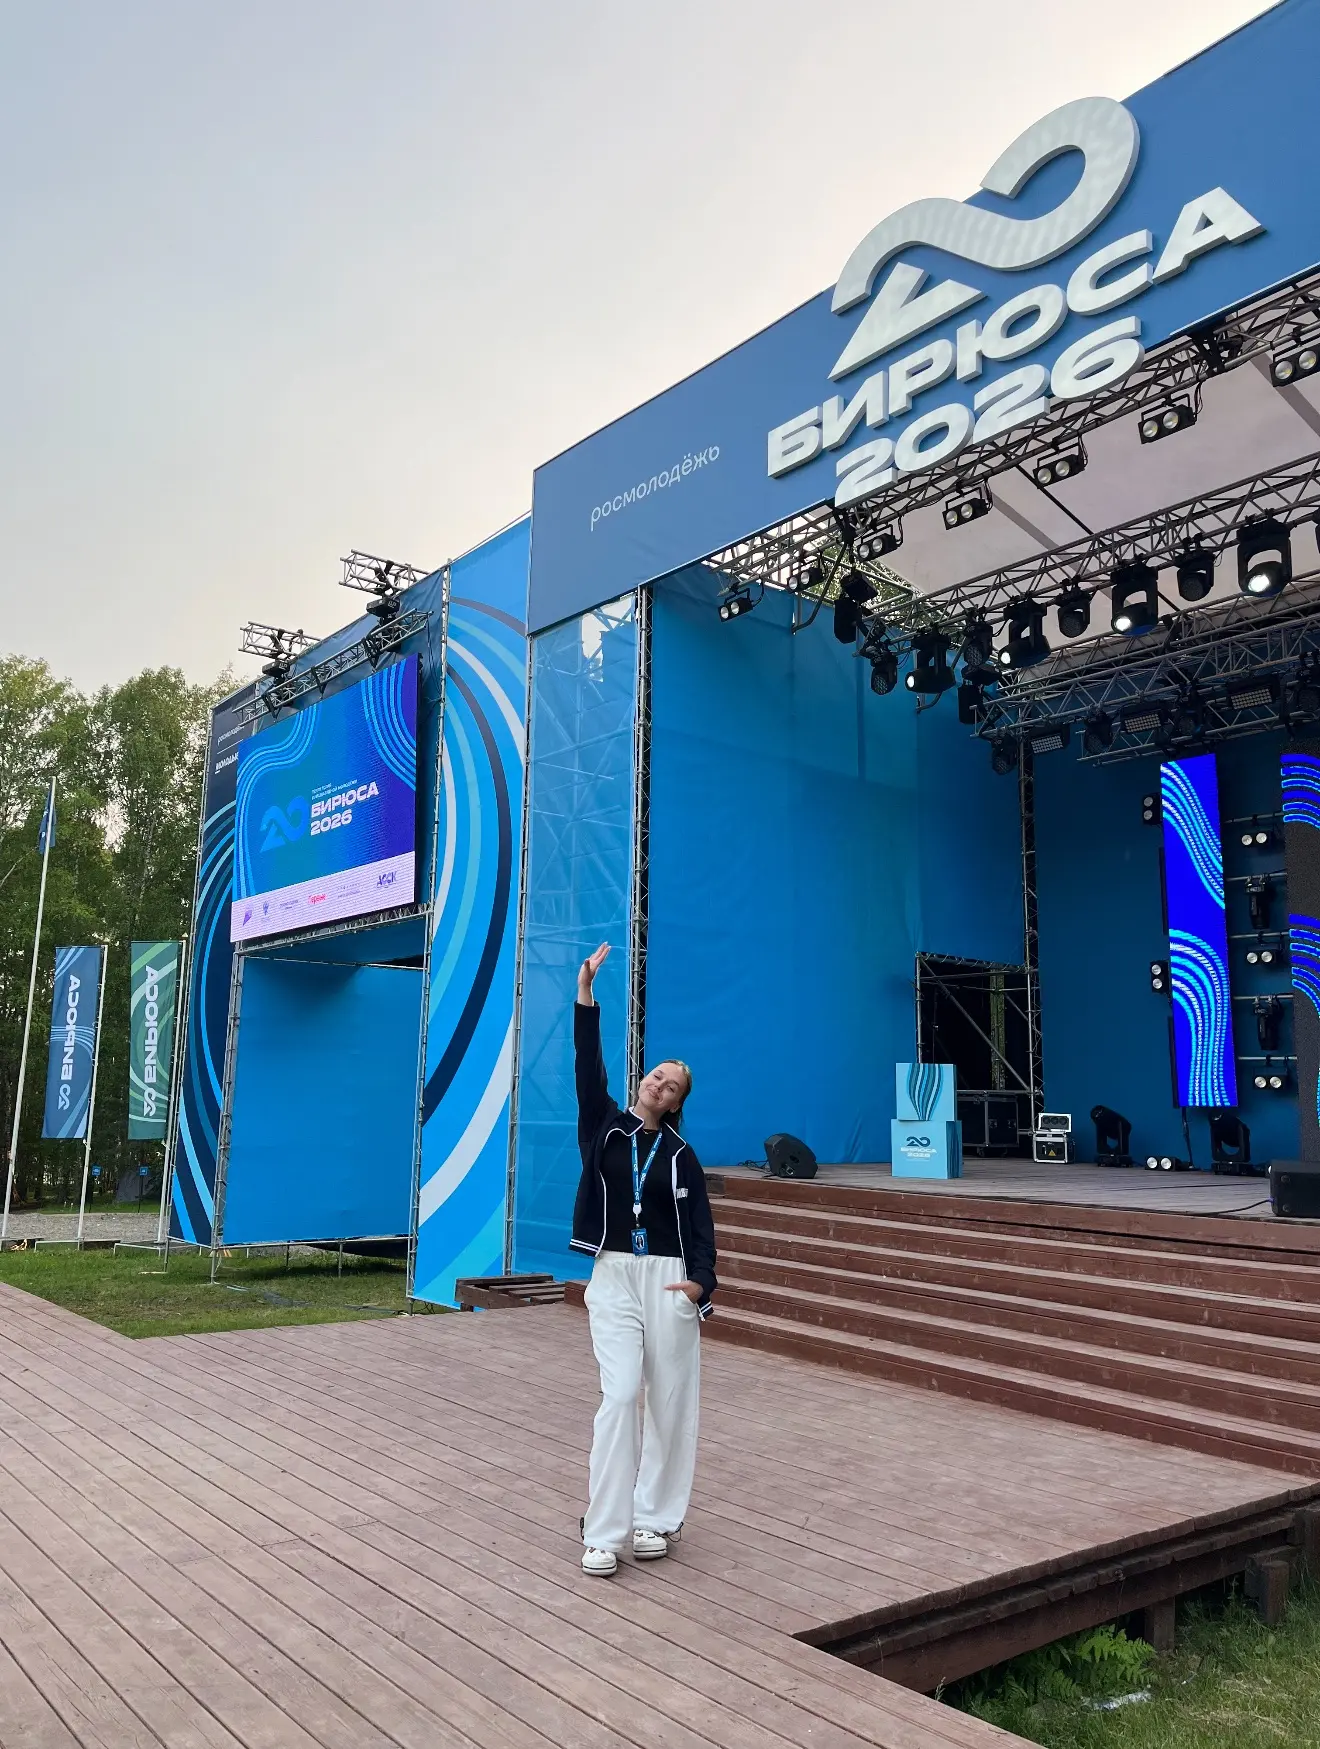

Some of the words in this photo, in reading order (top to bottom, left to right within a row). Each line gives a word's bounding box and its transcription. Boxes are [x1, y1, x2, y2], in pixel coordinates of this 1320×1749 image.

[767, 186, 1266, 478] БИРЮСА
[834, 316, 1146, 508] 2026
[590, 445, 720, 532] росмолодёжь
[310, 808, 353, 836] 2026
[311, 780, 379, 818] БИРЮСА
